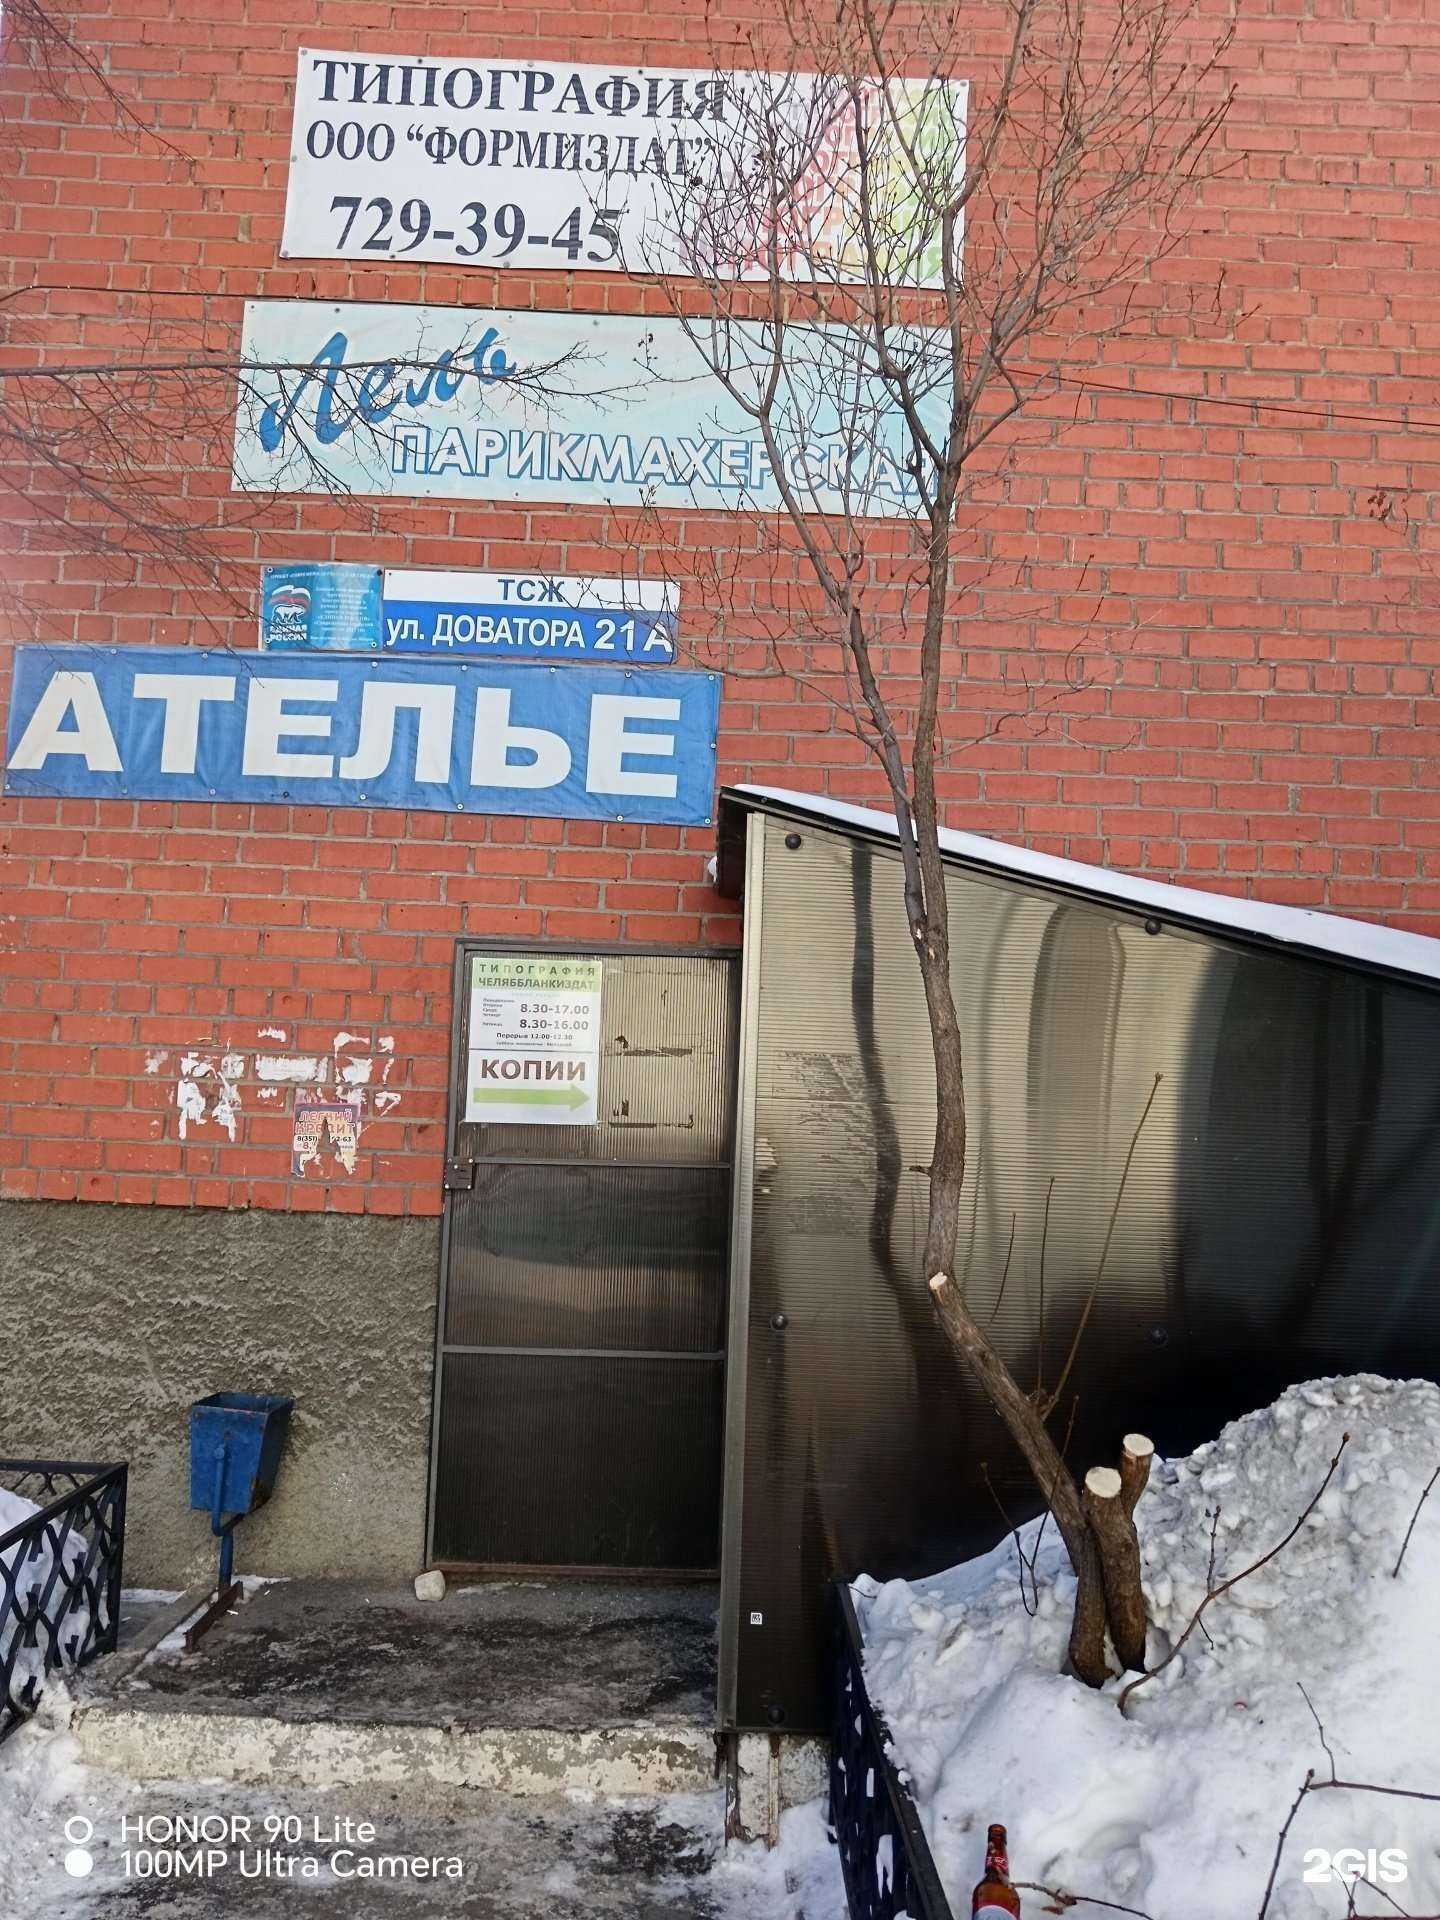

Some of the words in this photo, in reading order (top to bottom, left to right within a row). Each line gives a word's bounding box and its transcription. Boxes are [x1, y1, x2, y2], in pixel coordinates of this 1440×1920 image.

[313, 59, 729, 121] ТИПОГРАФИЯ
[306, 120, 395, 162] ООО
[330, 196, 622, 263] 729-39-45
[498, 578, 564, 602] ТСЖ
[386, 618, 424, 645] ул.
[432, 613, 585, 648] ДОВАТОРА
[6, 670, 681, 799] АТЕЛЬЕ
[479, 963, 595, 977] ТИПОГРАФИЯ
[478, 976, 594, 990] ЧЕЛЯББЛАНКИЗДАТ
[520, 1003, 589, 1015] 8.30-17.00
[519, 1019, 589, 1030] 8.30-16.00
[480, 1059, 586, 1081] КОПИИ
